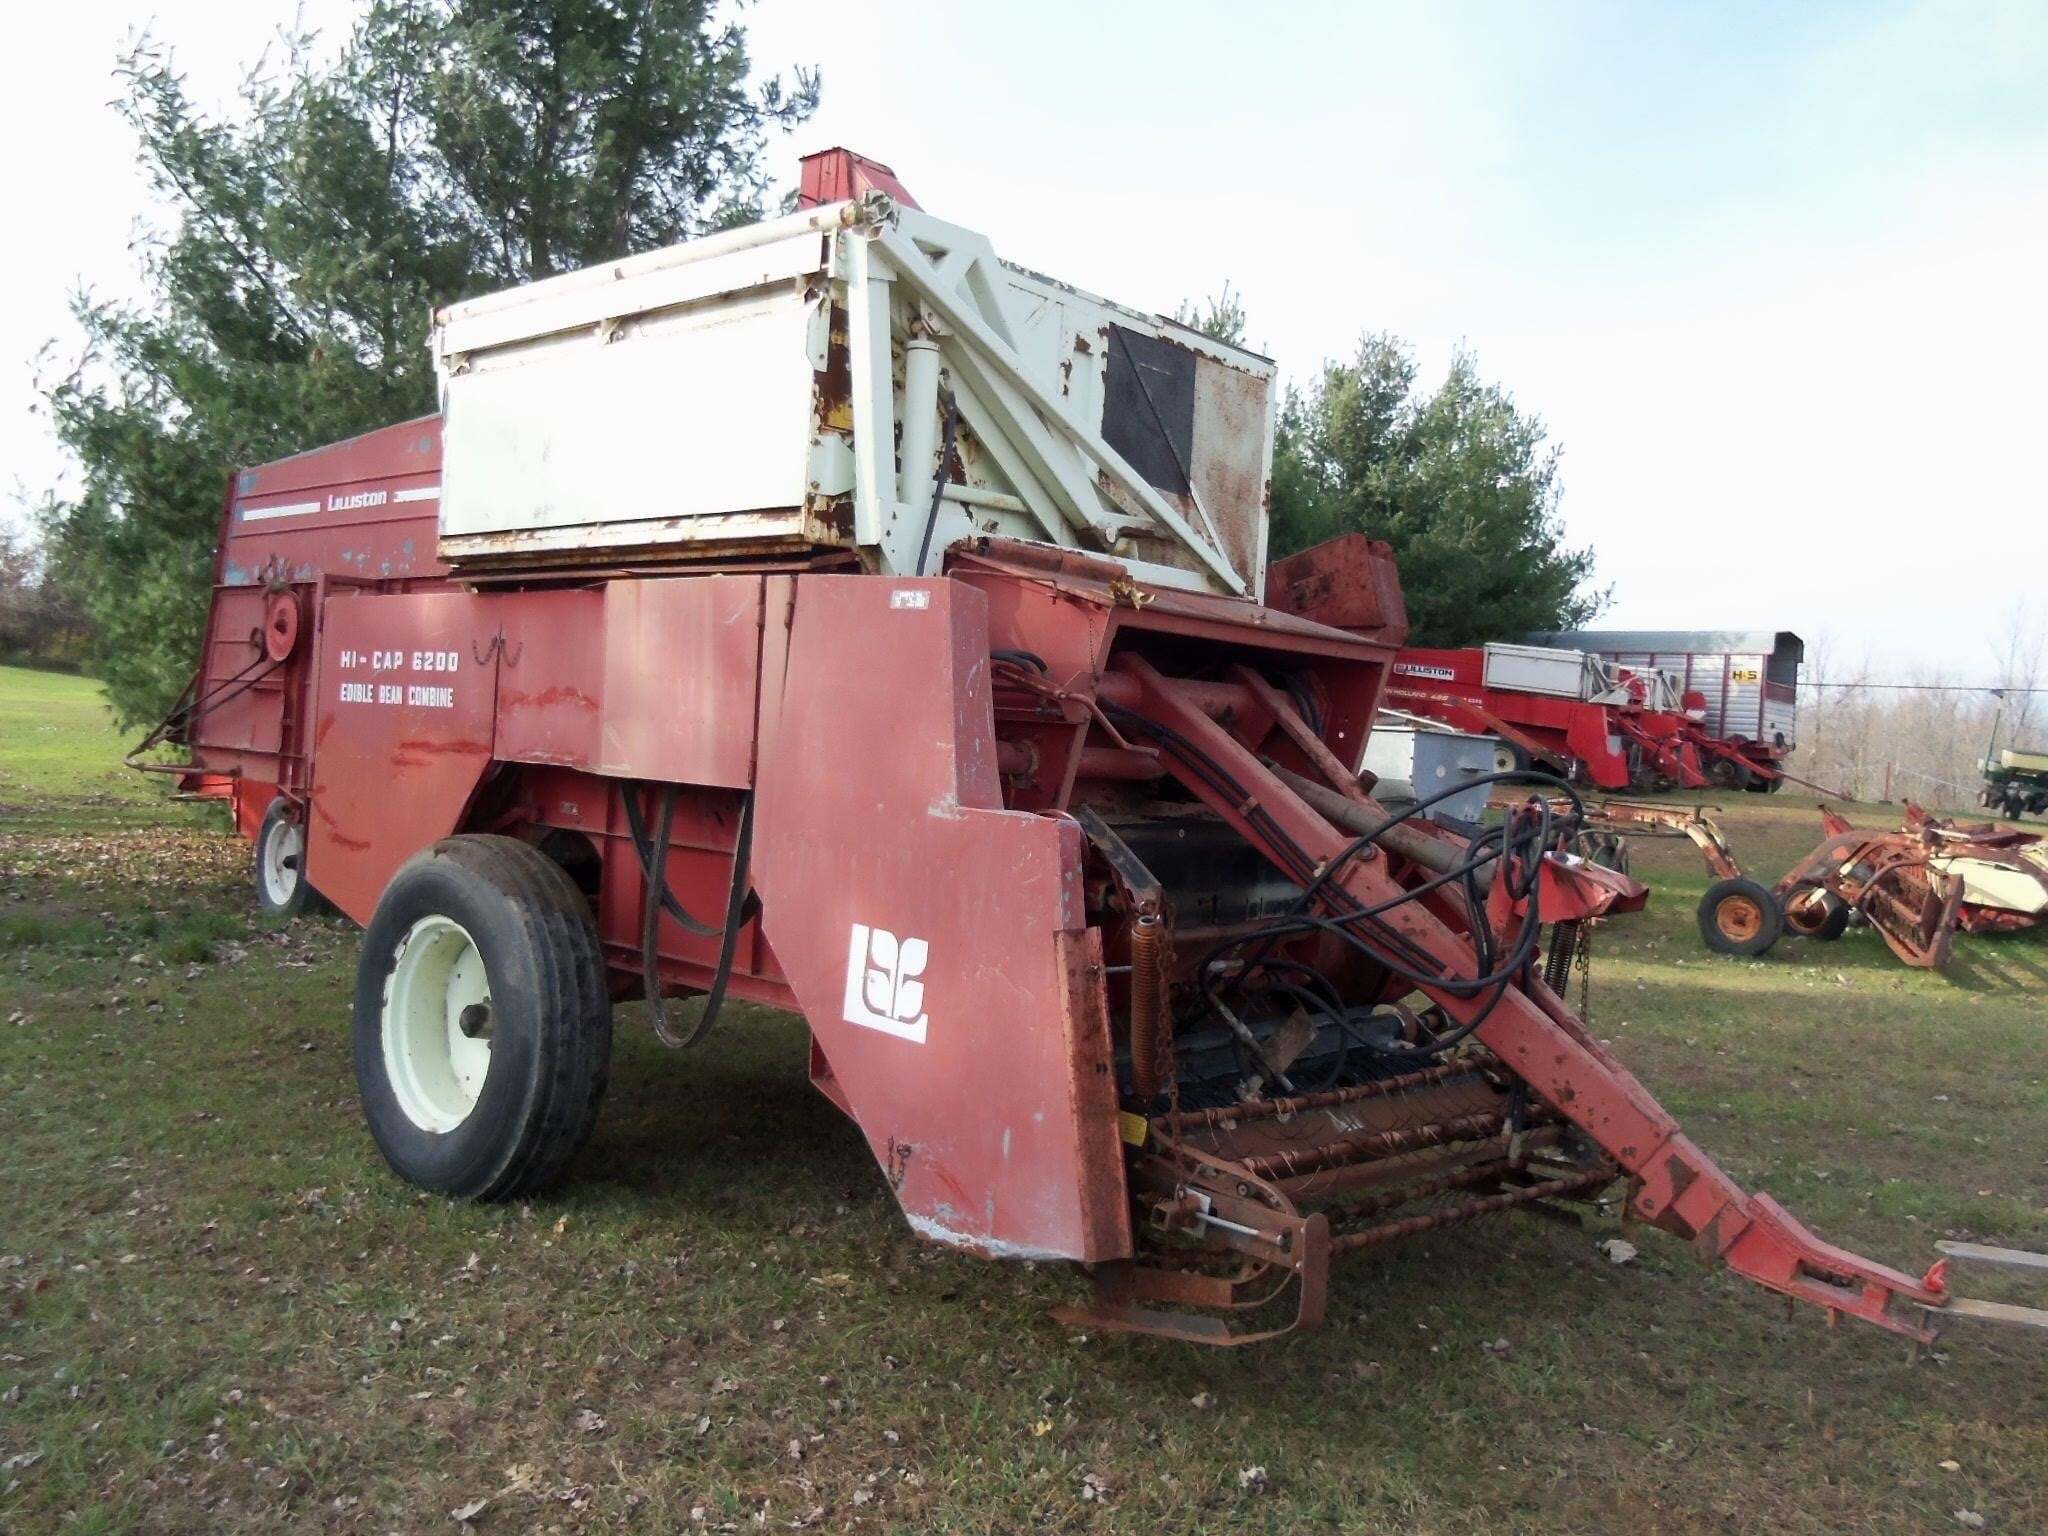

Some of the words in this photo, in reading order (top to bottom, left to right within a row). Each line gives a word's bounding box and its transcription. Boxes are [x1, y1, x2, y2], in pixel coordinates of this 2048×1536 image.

[372, 651, 403, 669] CAP
[412, 651, 459, 672] 6200
[341, 683, 374, 704] EDIBLE
[379, 684, 403, 705] BEAN
[408, 685, 454, 708] COMBINE
